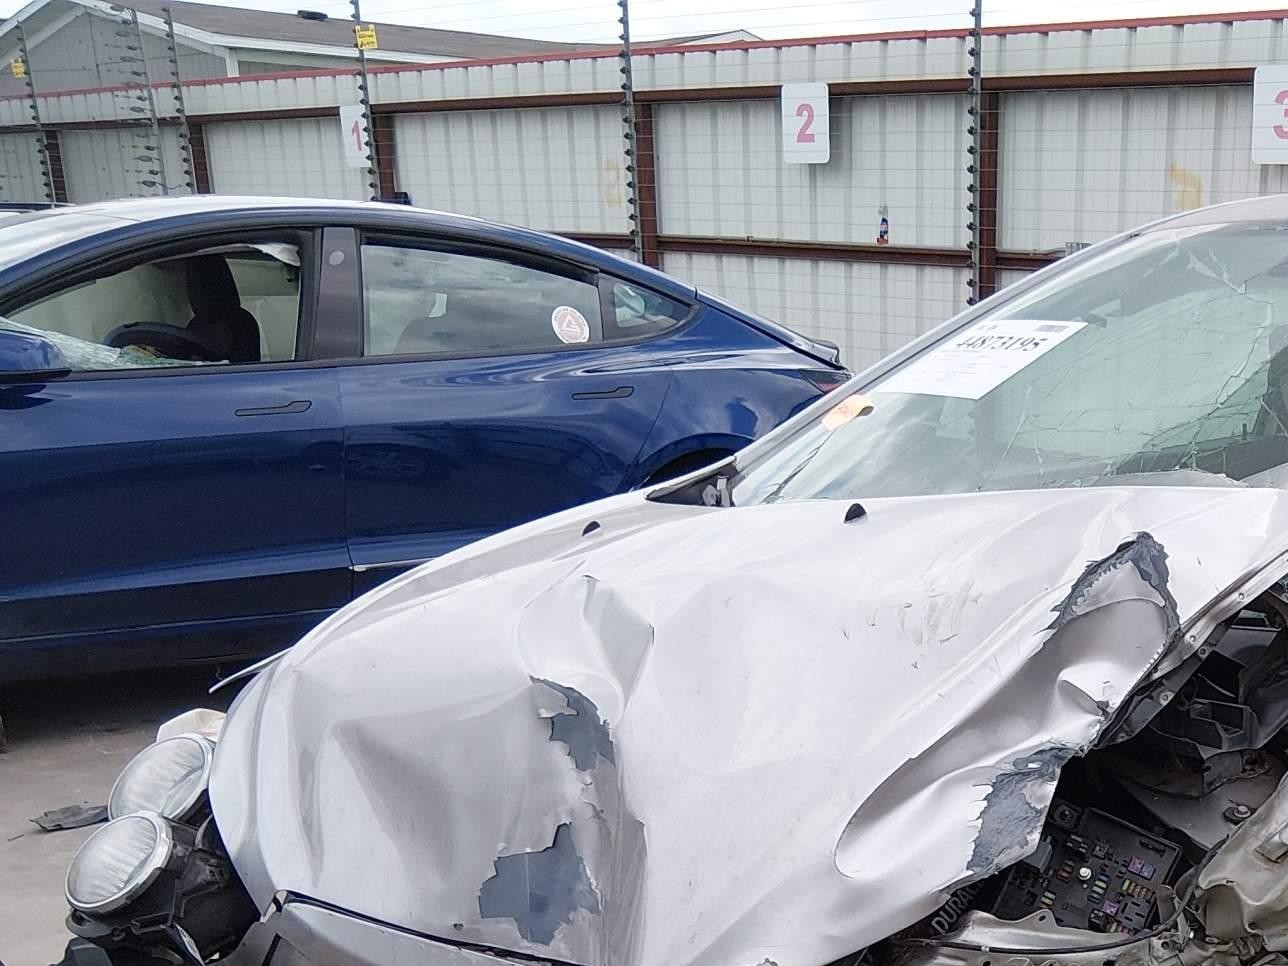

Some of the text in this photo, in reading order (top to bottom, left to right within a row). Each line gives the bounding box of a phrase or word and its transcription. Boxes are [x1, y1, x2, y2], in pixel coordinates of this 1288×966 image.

[352, 120, 362, 151] 1
[795, 103, 816, 144] 2
[956, 335, 1048, 352] 44873195
